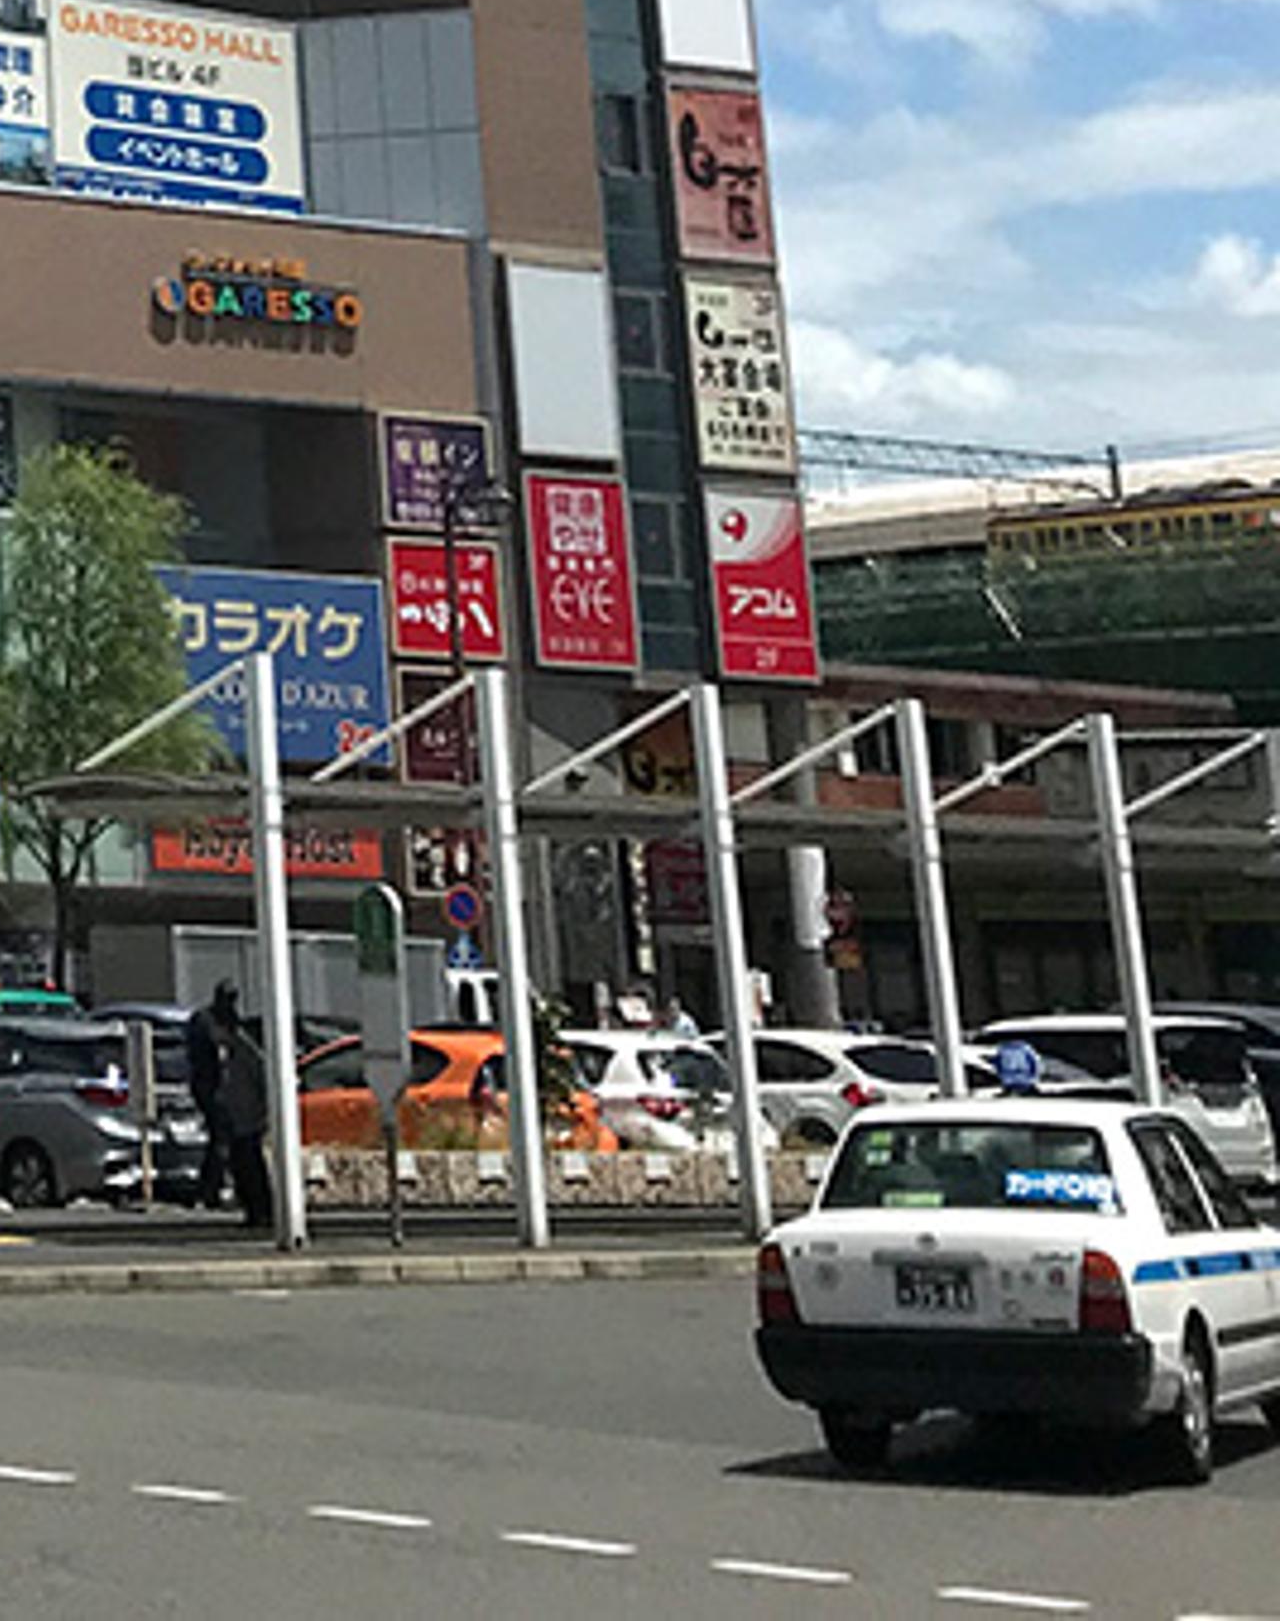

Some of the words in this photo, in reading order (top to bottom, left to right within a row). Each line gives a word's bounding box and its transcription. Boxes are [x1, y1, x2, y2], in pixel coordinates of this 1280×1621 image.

[59, 4, 199, 53] GARESSO
[204, 30, 283, 65] HALL
[188, 279, 363, 328] GARESSO
[550, 573, 616, 625] EYE
[727, 583, 797, 618] アコム
[161, 596, 365, 658] カラオケ
